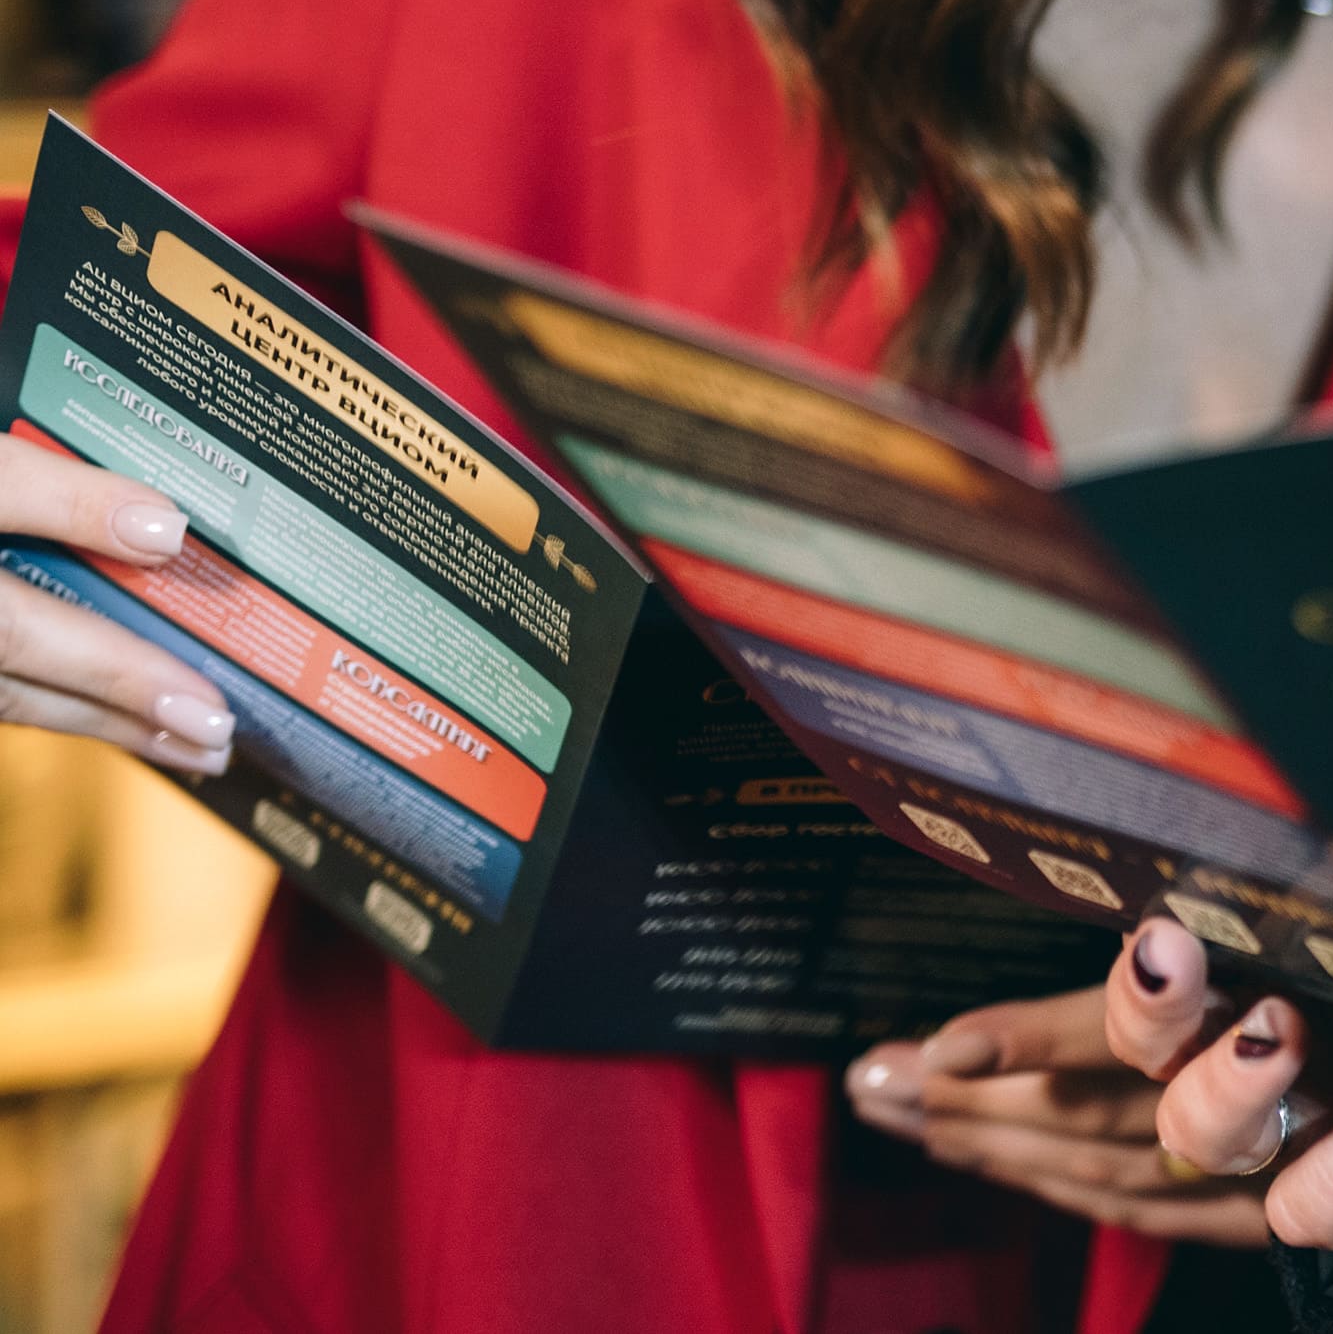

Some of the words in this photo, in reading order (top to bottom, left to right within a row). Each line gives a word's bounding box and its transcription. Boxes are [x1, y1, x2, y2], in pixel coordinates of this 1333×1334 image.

[63, 349, 248, 484] ИССЛЕДОВАНИЯ
[63, 291, 198, 388] консалтингового
[199, 384, 213, 398] и
[214, 395, 380, 514] коммуникационного
[381, 511, 507, 609] сопровождения
[508, 606, 569, 664] проекта
[68, 277, 96, 304] Мы
[97, 300, 214, 385] обеспечиваем
[216, 381, 279, 430] полный
[281, 426, 359, 485] комплекс
[74, 269, 123, 308] центр
[123, 304, 136, 317] с
[137, 313, 211, 369] широкой
[212, 365, 293, 425] линейкой
[295, 421, 389, 493] экспертных
[391, 489, 465, 550] решений
[465, 545, 496, 575] для
[81, 260, 107, 286] АЦ
[109, 277, 173, 328] ВЦИОМ
[175, 323, 252, 383] СЕГОДНЯ
[272, 391, 300, 416] это
[302, 412, 452, 525] многопрофильный
[454, 523, 571, 623] аналитический
[135, 355, 197, 401] любого
[197, 397, 257, 443] уровня
[258, 439, 345, 504] сложности
[347, 499, 360, 515] и
[361, 510, 493, 612] ответственности.
[211, 282, 478, 479] АНАЛИТИЧЕСКИЙ
[230, 318, 330, 393] ЦЕНТР
[337, 394, 449, 483] ВЦИОМ
[329, 647, 489, 759] КОНСАЛТИНГ
